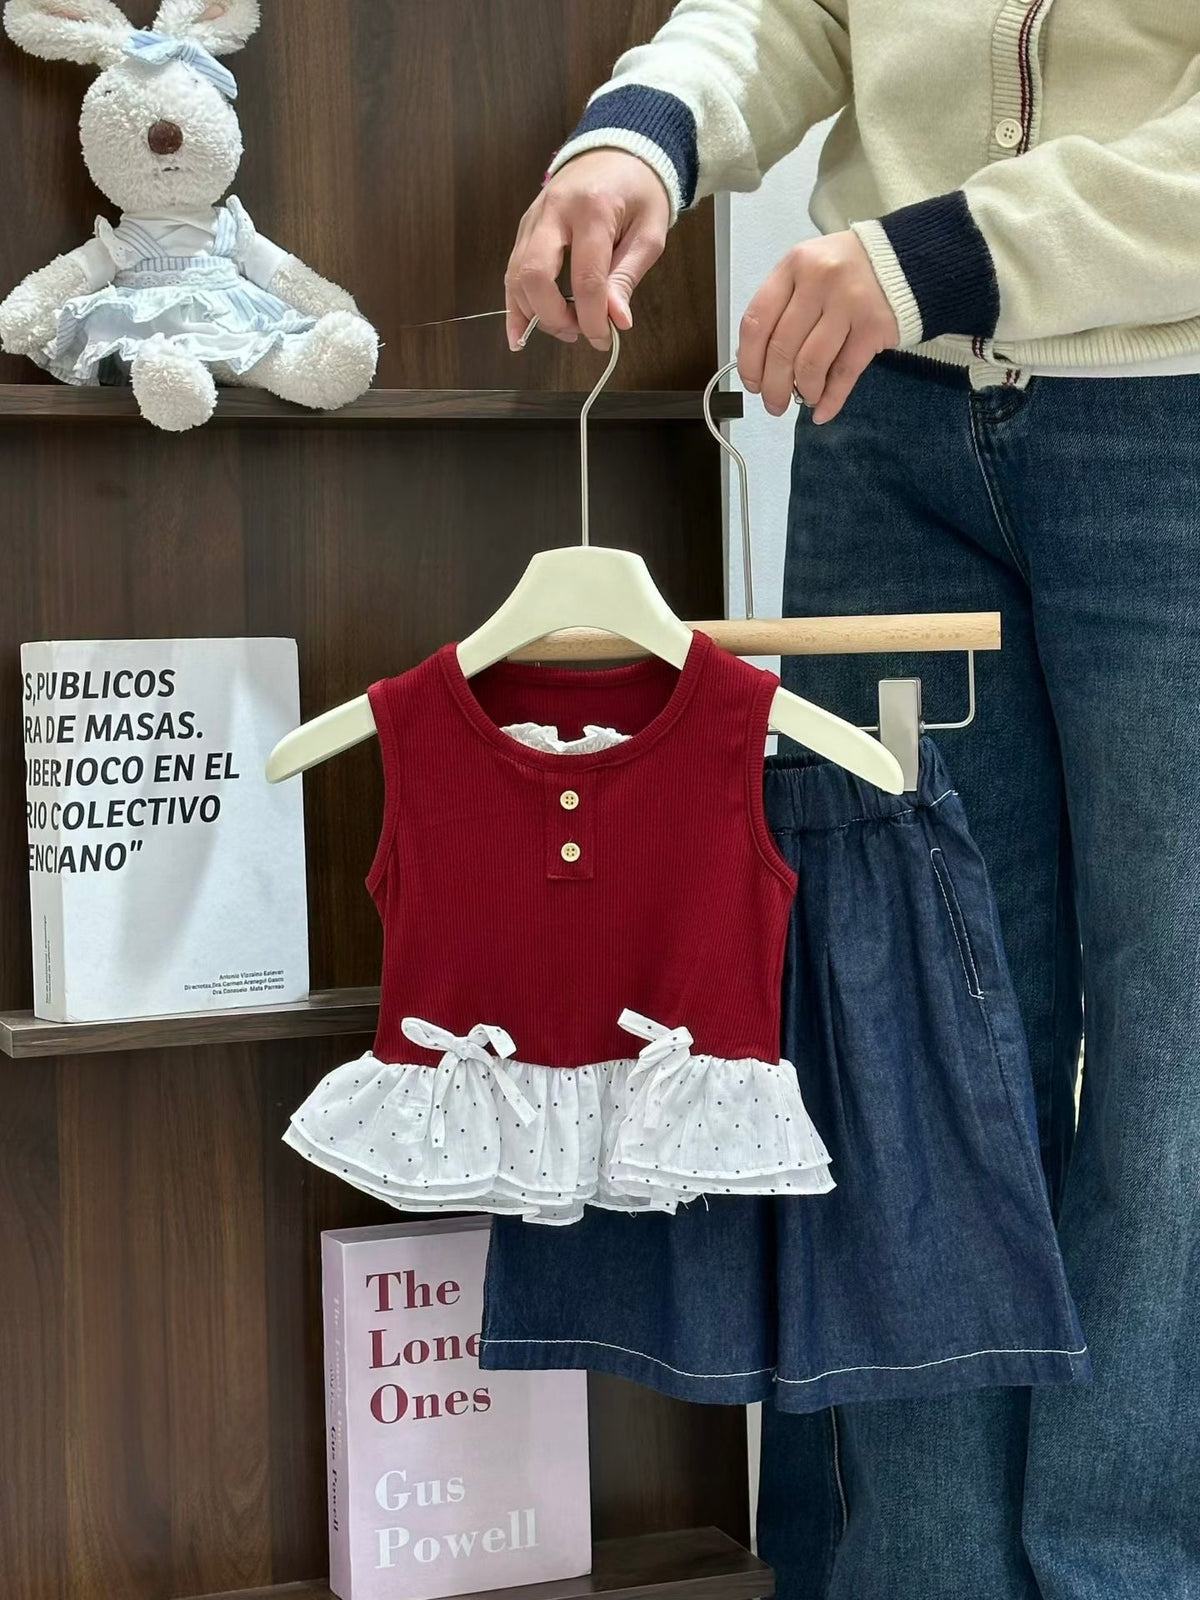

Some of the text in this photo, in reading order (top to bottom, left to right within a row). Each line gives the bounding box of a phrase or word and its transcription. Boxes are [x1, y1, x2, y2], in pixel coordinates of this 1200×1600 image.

[46, 715, 76, 743] DE
[85, 711, 203, 743] MASAS.
[26, 752, 240, 787] IBERIOCO EN EL
[51, 795, 221, 830] COLECTIVO
[366, 1269, 461, 1312] The
[368, 1329, 480, 1369] Lone
[370, 1383, 492, 1425] Ones
[374, 1470, 466, 1511] Gus
[374, 1508, 540, 1569] Powell
